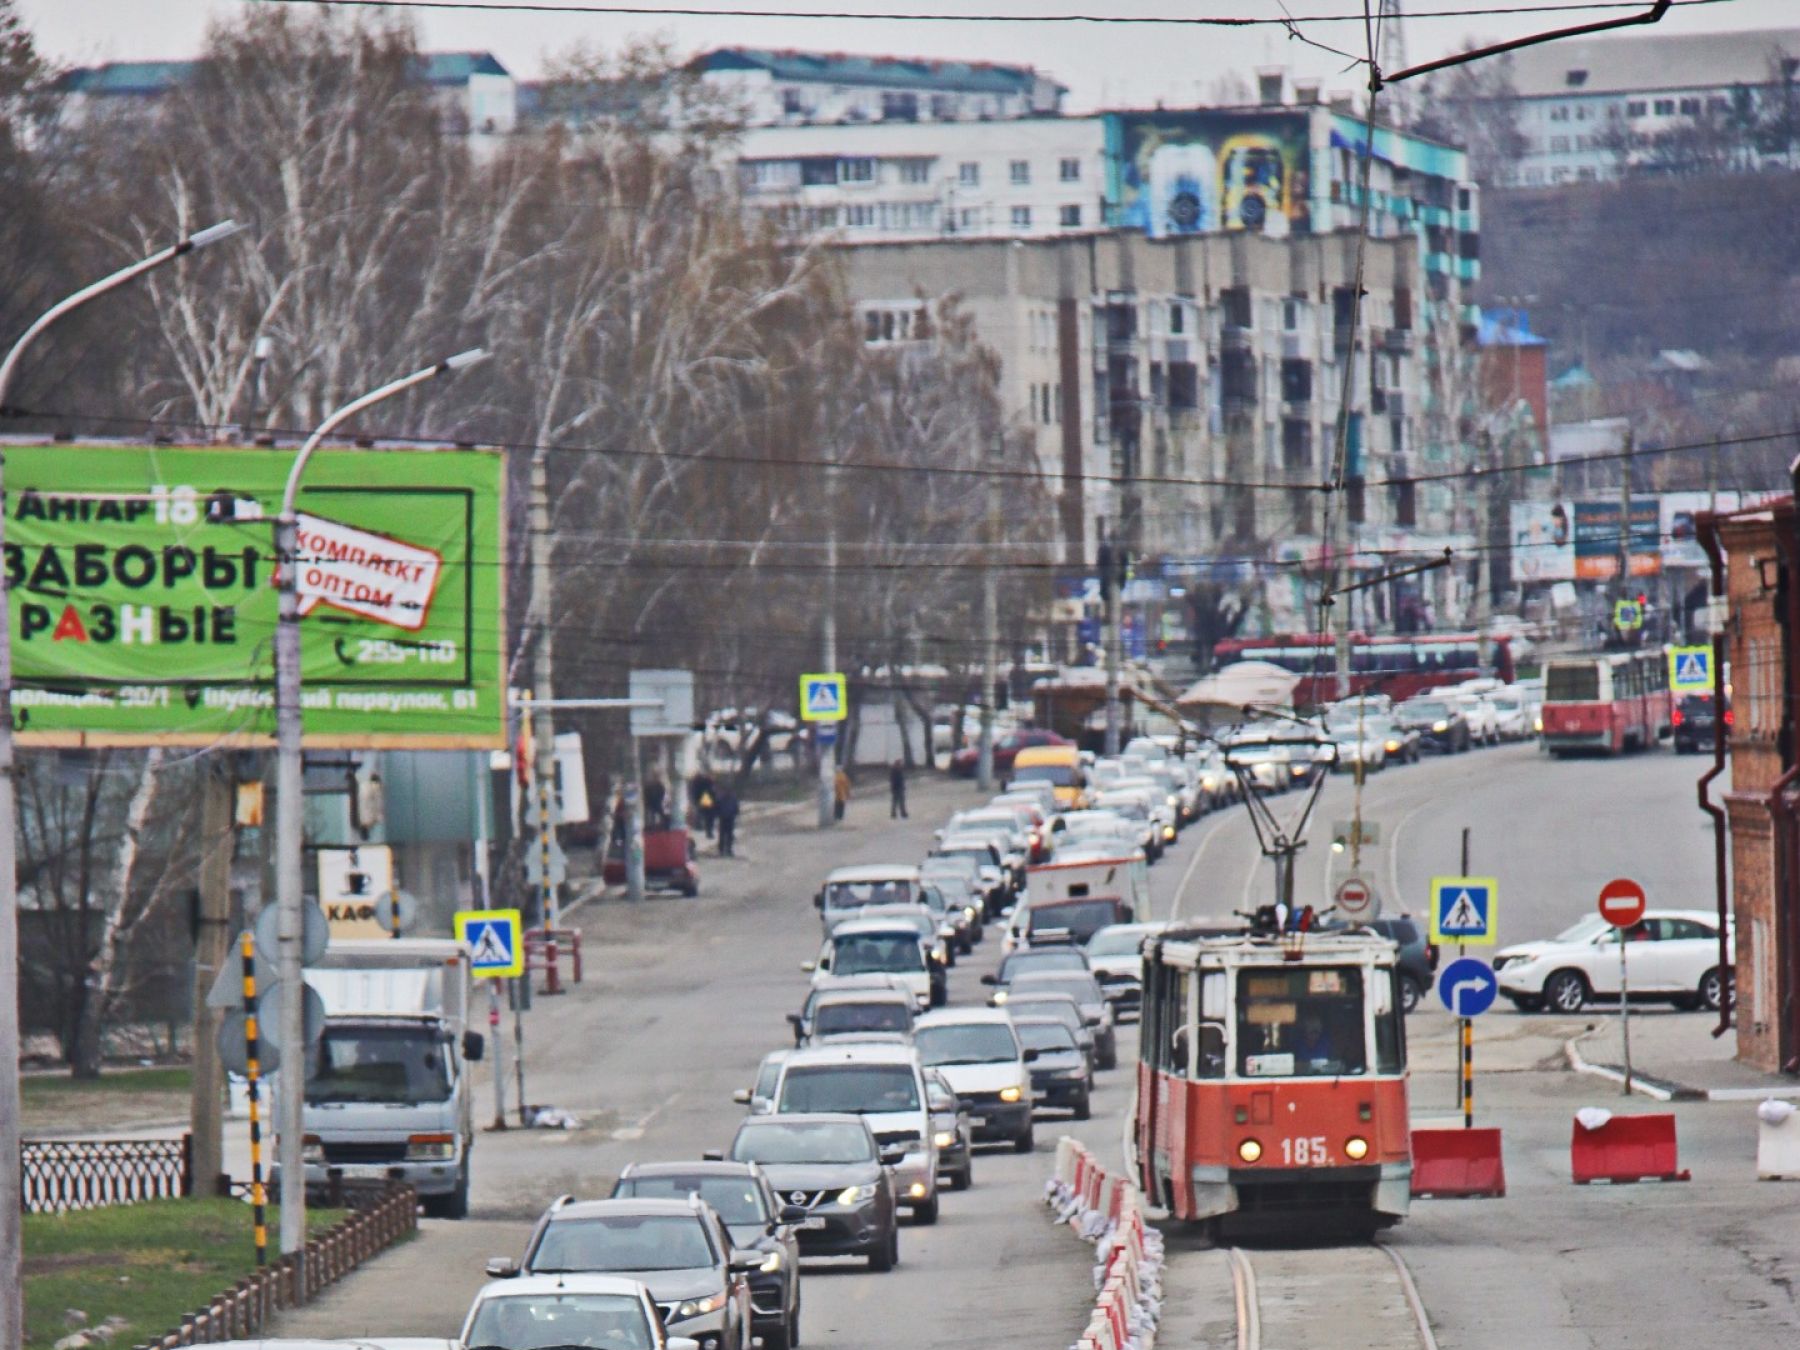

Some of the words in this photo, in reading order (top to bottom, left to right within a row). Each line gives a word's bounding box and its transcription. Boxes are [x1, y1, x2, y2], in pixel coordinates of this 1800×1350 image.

[306, 569, 394, 609] ОПТОМ
[20, 603, 237, 644] РАЗНЫЕ
[328, 904, 378, 921] КАФ
[1281, 1136, 1328, 1166] 185
